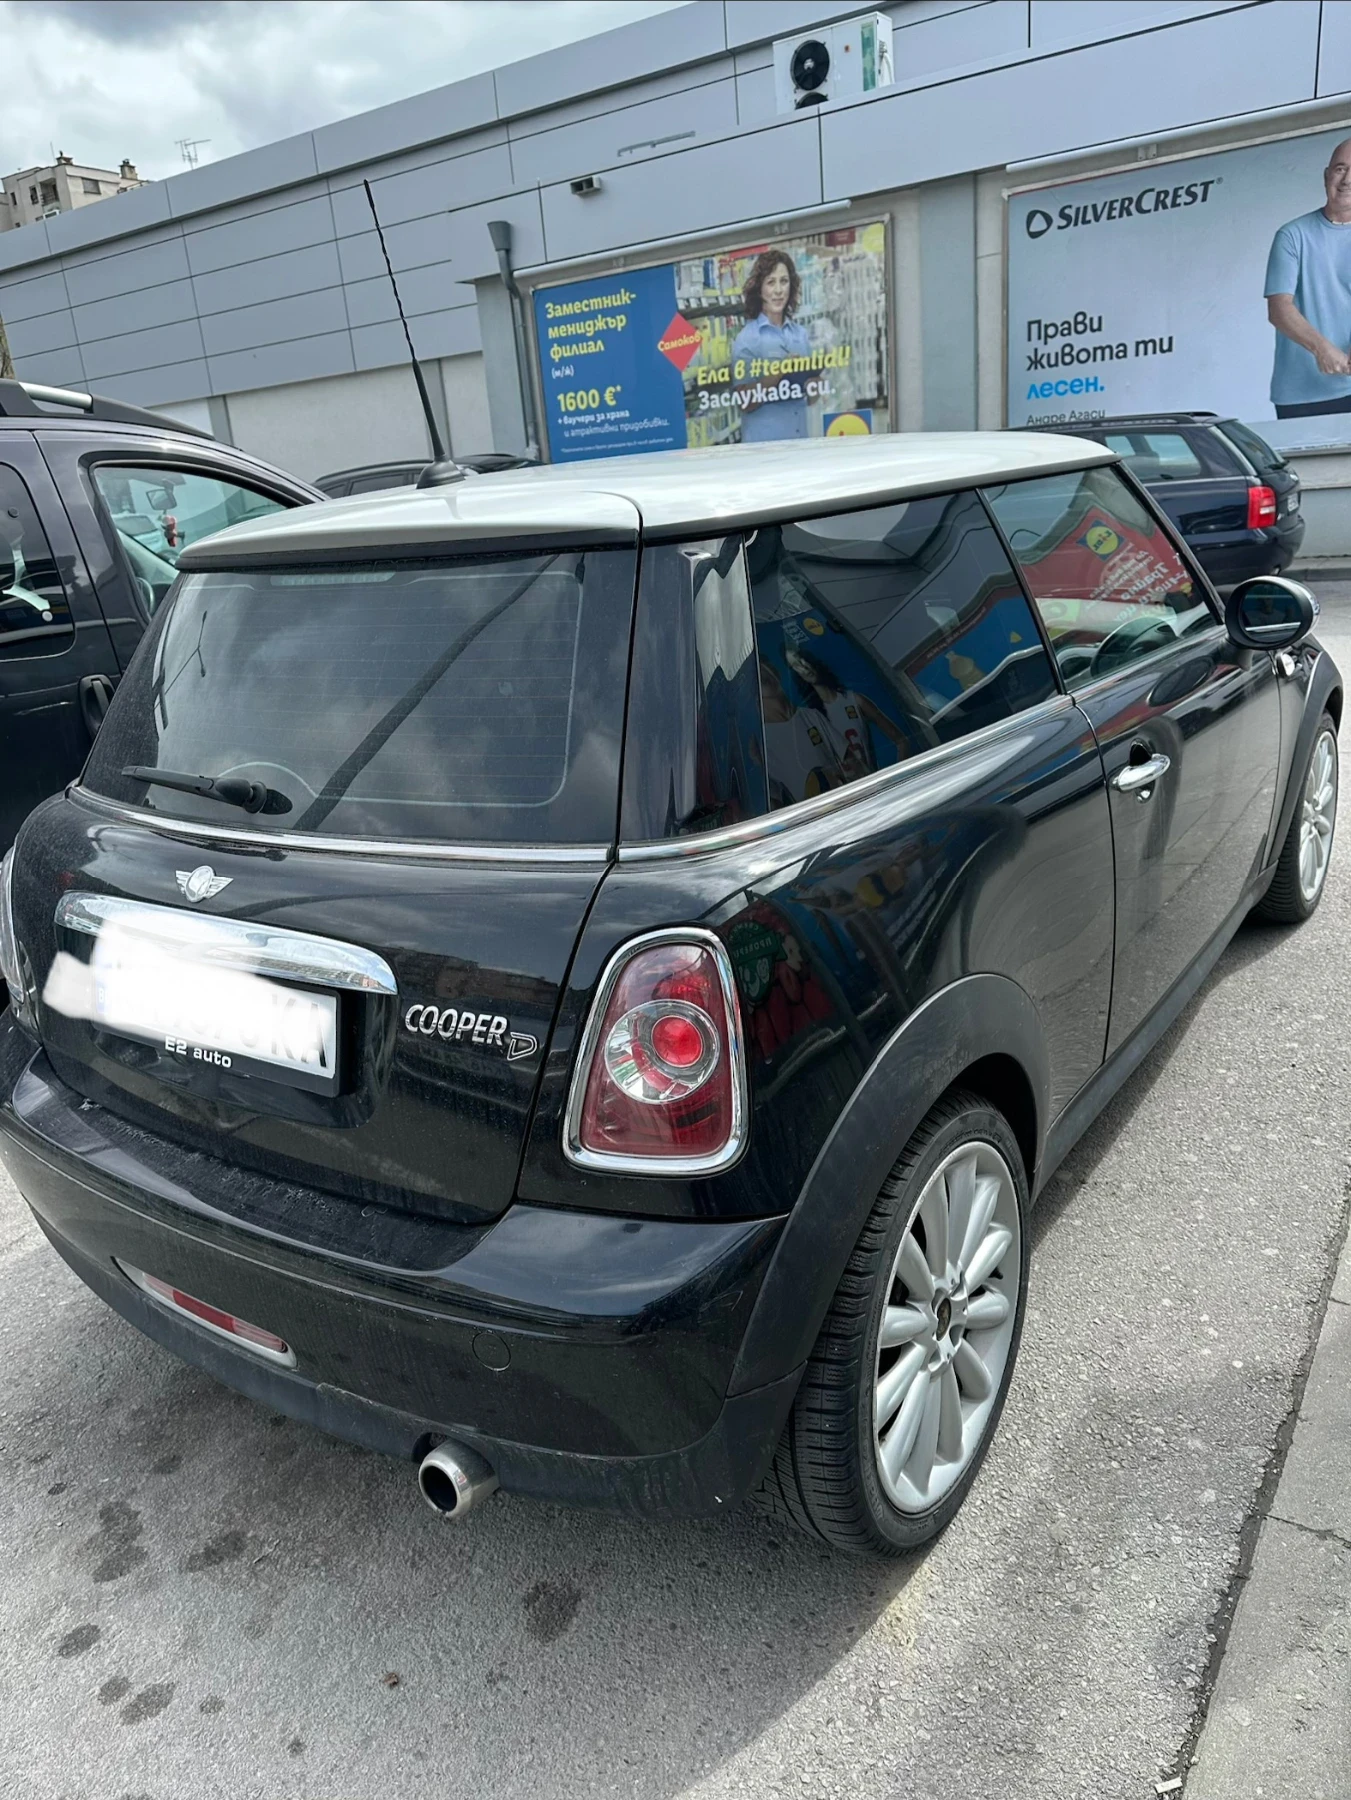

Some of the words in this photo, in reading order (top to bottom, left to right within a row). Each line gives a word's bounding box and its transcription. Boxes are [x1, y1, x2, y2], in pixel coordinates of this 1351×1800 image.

[545, 288, 636, 319] Заместник-
[548, 314, 627, 339] мениджър
[658, 332, 702, 351] Самоков
[1027, 311, 1103, 345] Прави
[550, 339, 605, 362] филиал
[697, 366, 730, 385] Ела
[734, 361, 745, 379] в
[750, 345, 850, 378] #teamlidl!
[1026, 343, 1128, 371] живота
[1135, 336, 1174, 357] ти
[557, 389, 600, 412] 1600
[698, 379, 803, 410] Заслужава
[807, 379, 836, 397] си.
[1027, 376, 1105, 400] лесен.
[1069, 409, 1106, 422] Агаси
[405, 1004, 507, 1046] COOPER
[507, 1032, 538, 1061] D
[164, 1036, 188, 1055] E2
[193, 1047, 232, 1068] auto
